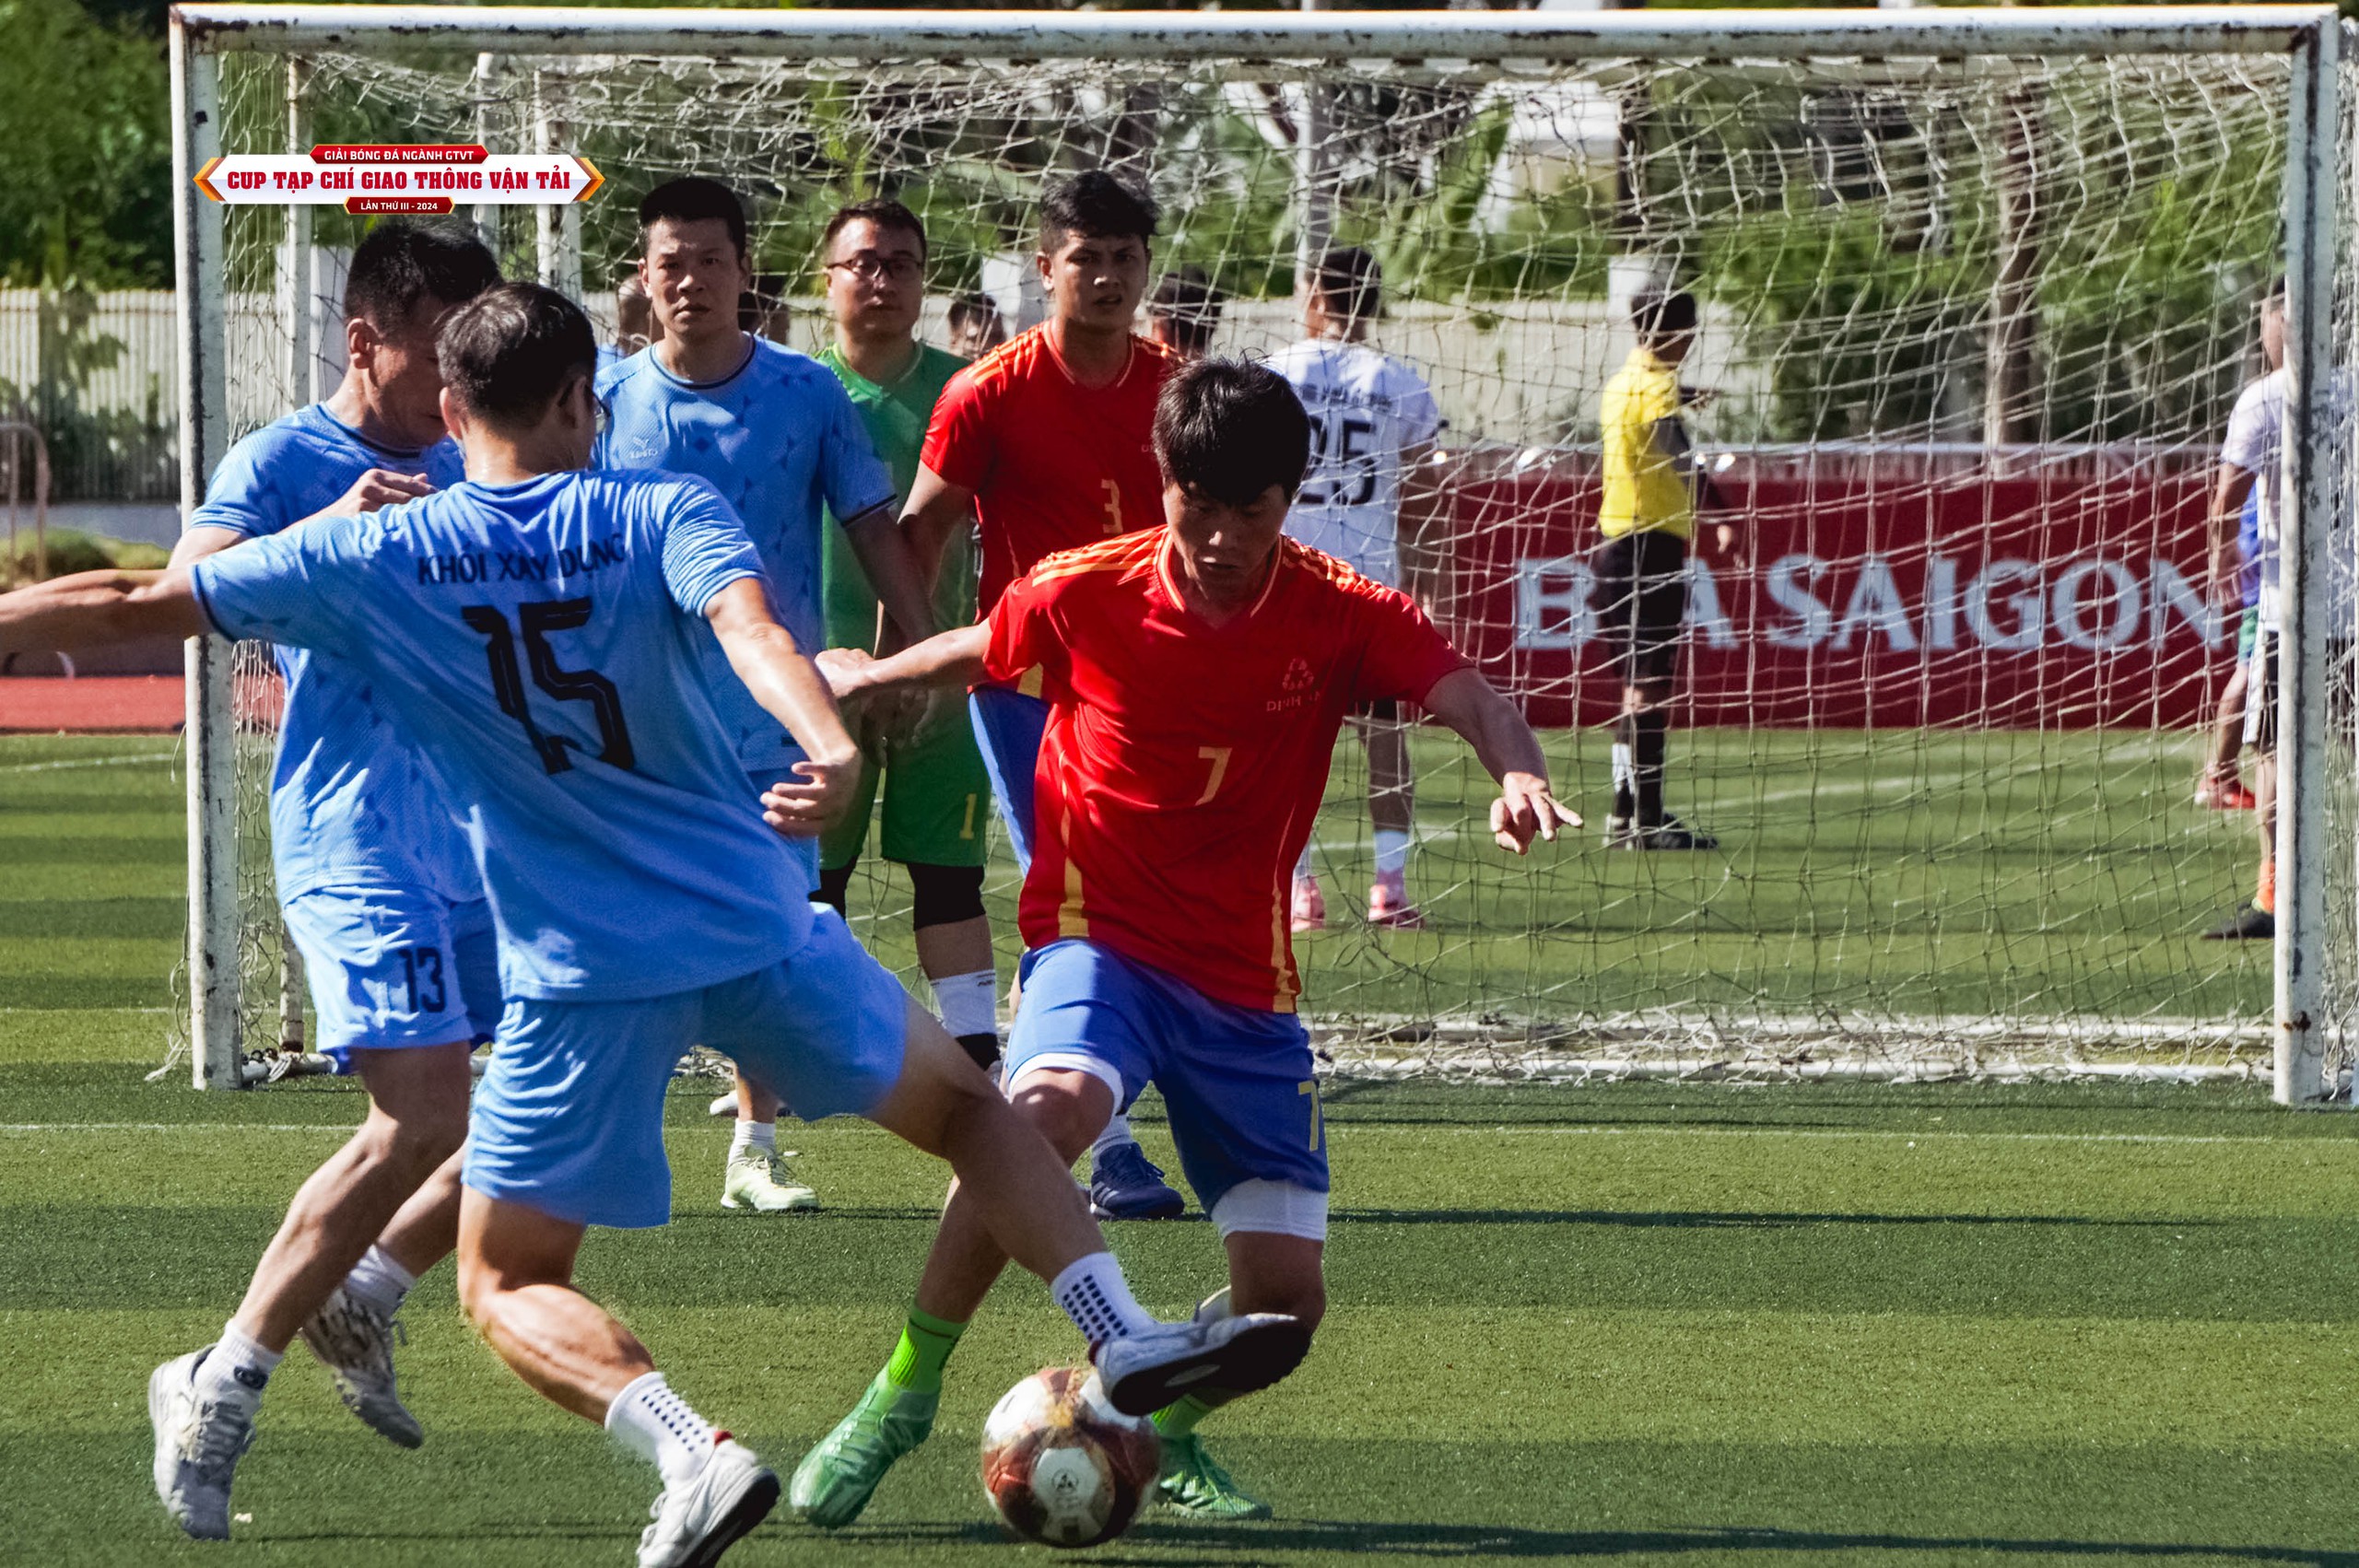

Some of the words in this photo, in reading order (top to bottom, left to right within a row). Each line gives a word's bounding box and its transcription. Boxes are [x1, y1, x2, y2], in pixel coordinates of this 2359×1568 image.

[1297, 415, 1377, 505] 25
[1100, 478, 1123, 533] 3
[1764, 553, 2224, 652] SAIGON
[462, 595, 636, 776] 15
[1194, 745, 1233, 807] 7
[959, 793, 977, 840] 1
[397, 946, 446, 1013] 13
[1297, 1080, 1320, 1152] 7
